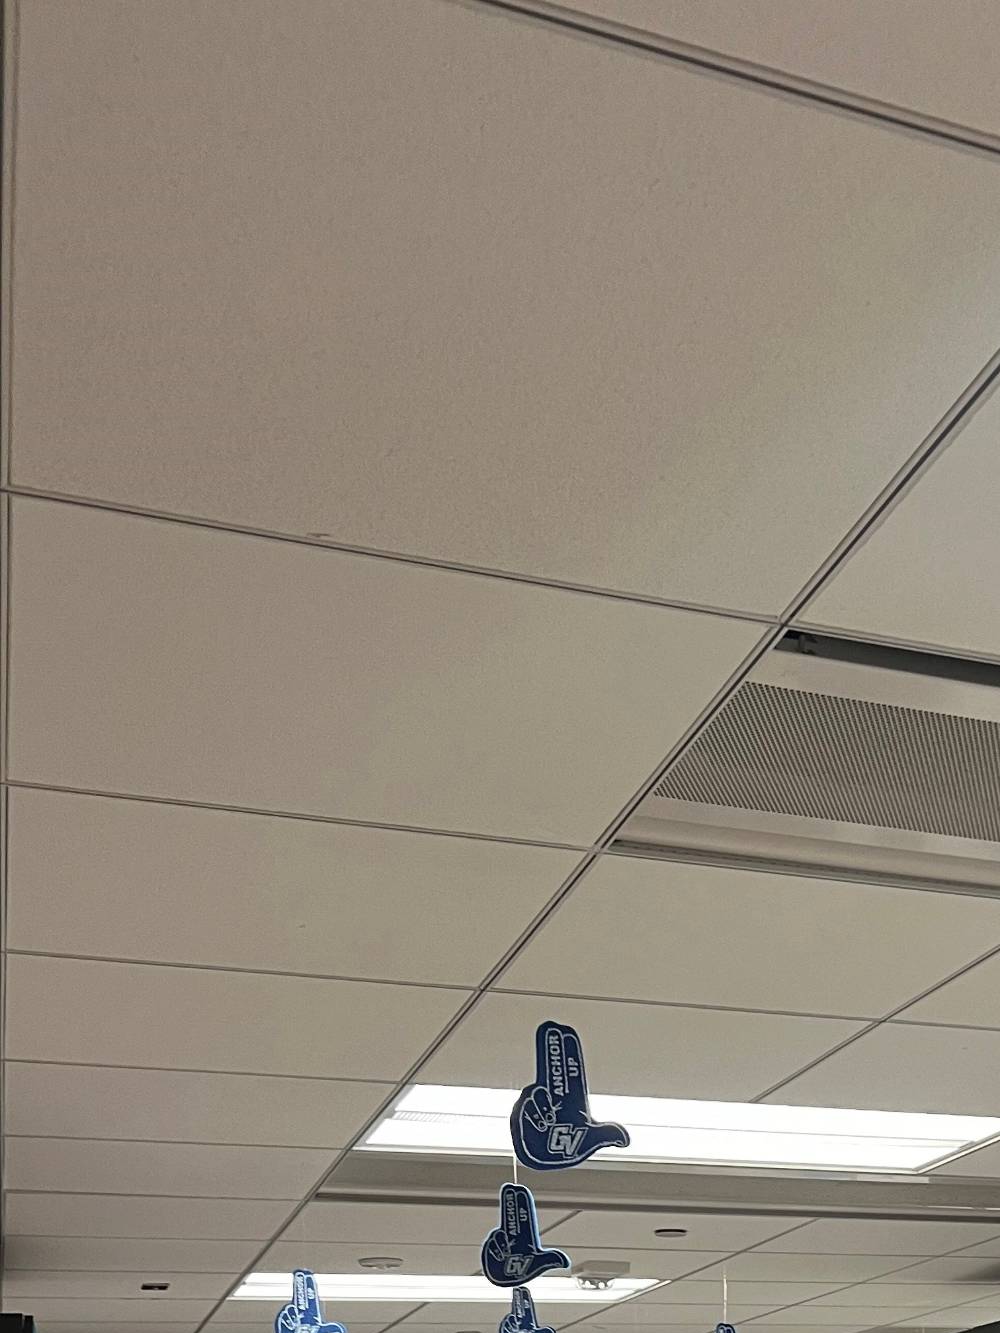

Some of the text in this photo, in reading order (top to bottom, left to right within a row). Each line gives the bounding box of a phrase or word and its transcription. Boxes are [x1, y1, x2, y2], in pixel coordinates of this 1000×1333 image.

[548, 1033, 565, 1096] ANCHOR
[568, 1057, 579, 1077] UP
[547, 1123, 588, 1158] GV
[505, 1193, 518, 1237] ANCHOR
[519, 1207, 528, 1222] UP
[503, 1253, 534, 1279] GV
